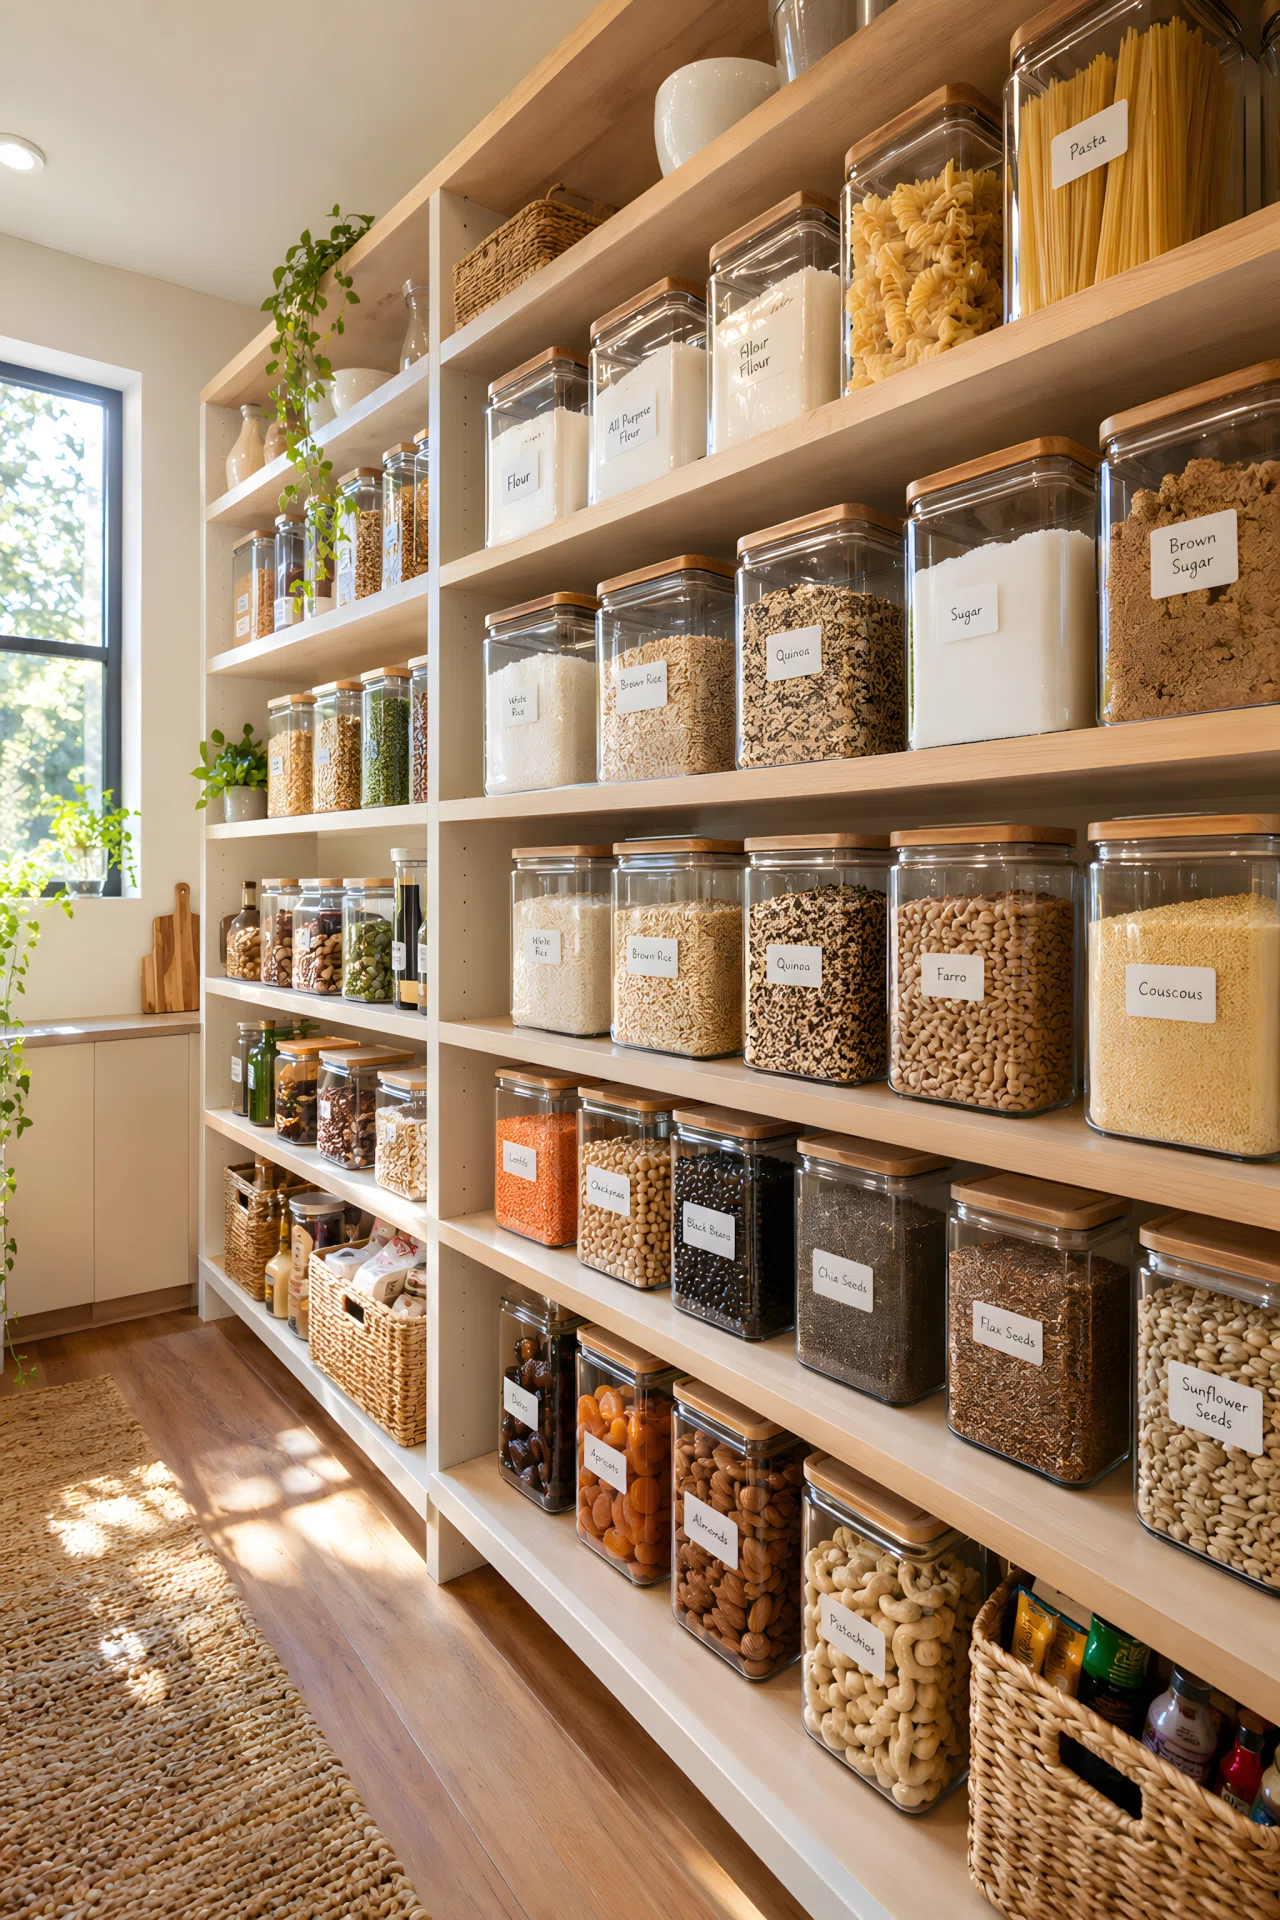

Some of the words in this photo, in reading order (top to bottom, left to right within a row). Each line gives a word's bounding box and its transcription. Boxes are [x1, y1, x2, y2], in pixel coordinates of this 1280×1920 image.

[1070, 134, 1107, 160] Pasta
[609, 417, 620, 434] All
[508, 472, 531, 491] Flour
[1170, 533, 1217, 554] Brown
[1172, 555, 1214, 579] Sugar
[951, 606, 983, 625] Sugar
[776, 648, 810, 664] Quinoa
[632, 949, 655, 960] Brown
[776, 957, 810, 972] Quinoa
[937, 967, 967, 983] Farro
[1138, 982, 1203, 1001] Couscous
[818, 1267, 838, 1284] Chia
[842, 1274, 867, 1293] Seeds
[980, 1316, 1002, 1336] Flax
[1006, 1326, 1036, 1348] Seeds
[1182, 1377, 1249, 1413] Sunflower
[1196, 1402, 1232, 1429] Seeds
